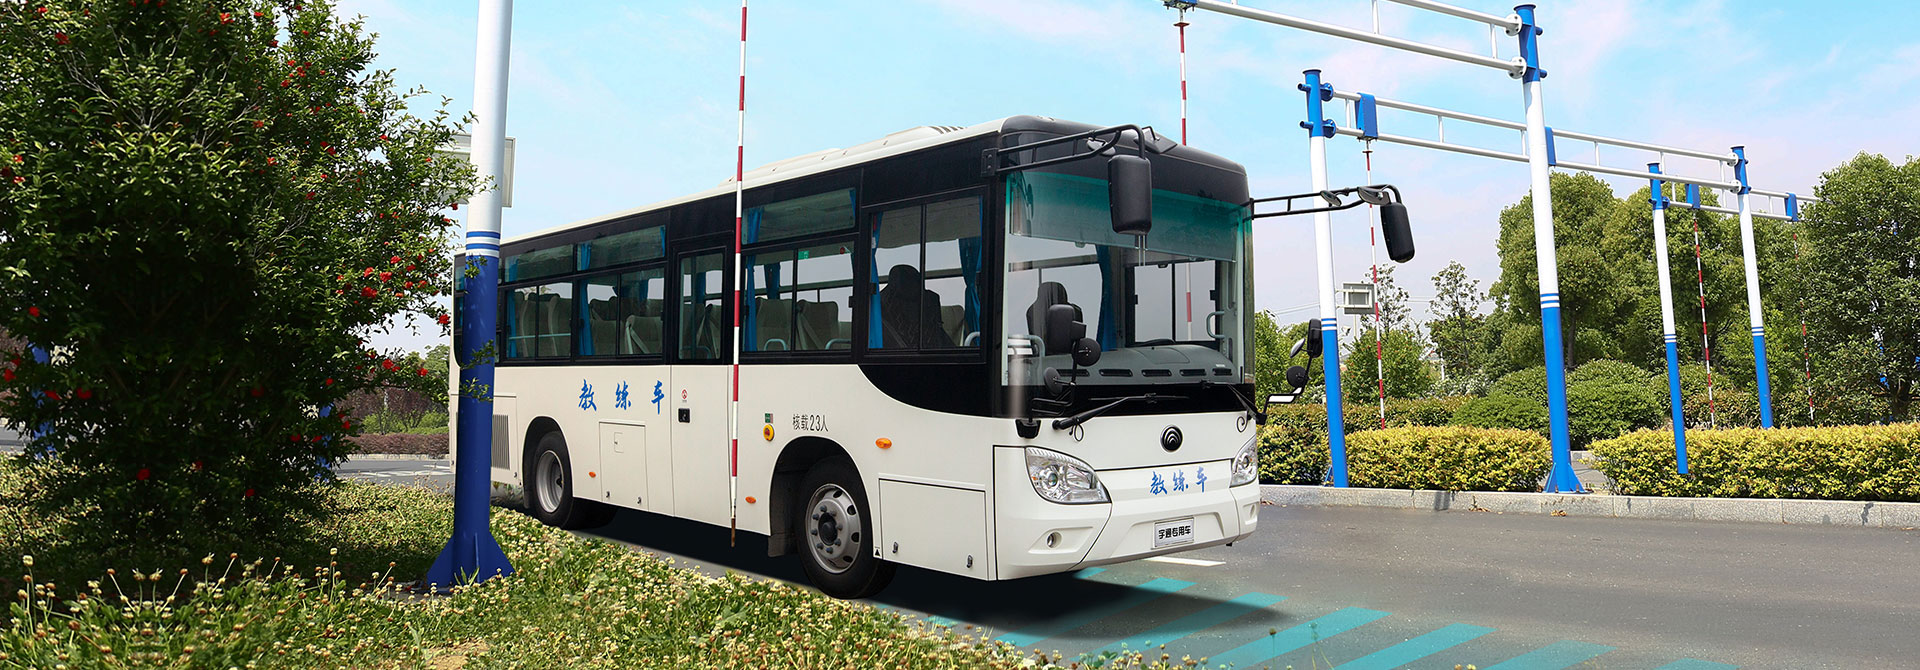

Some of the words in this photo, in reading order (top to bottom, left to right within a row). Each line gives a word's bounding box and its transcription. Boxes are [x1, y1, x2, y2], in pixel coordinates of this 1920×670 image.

[578, 378, 665, 415] 教练车
[792, 413, 829, 433] 核载23人
[1150, 466, 1207, 495] 教练车
[1158, 525, 1191, 540] 宇通专用车
